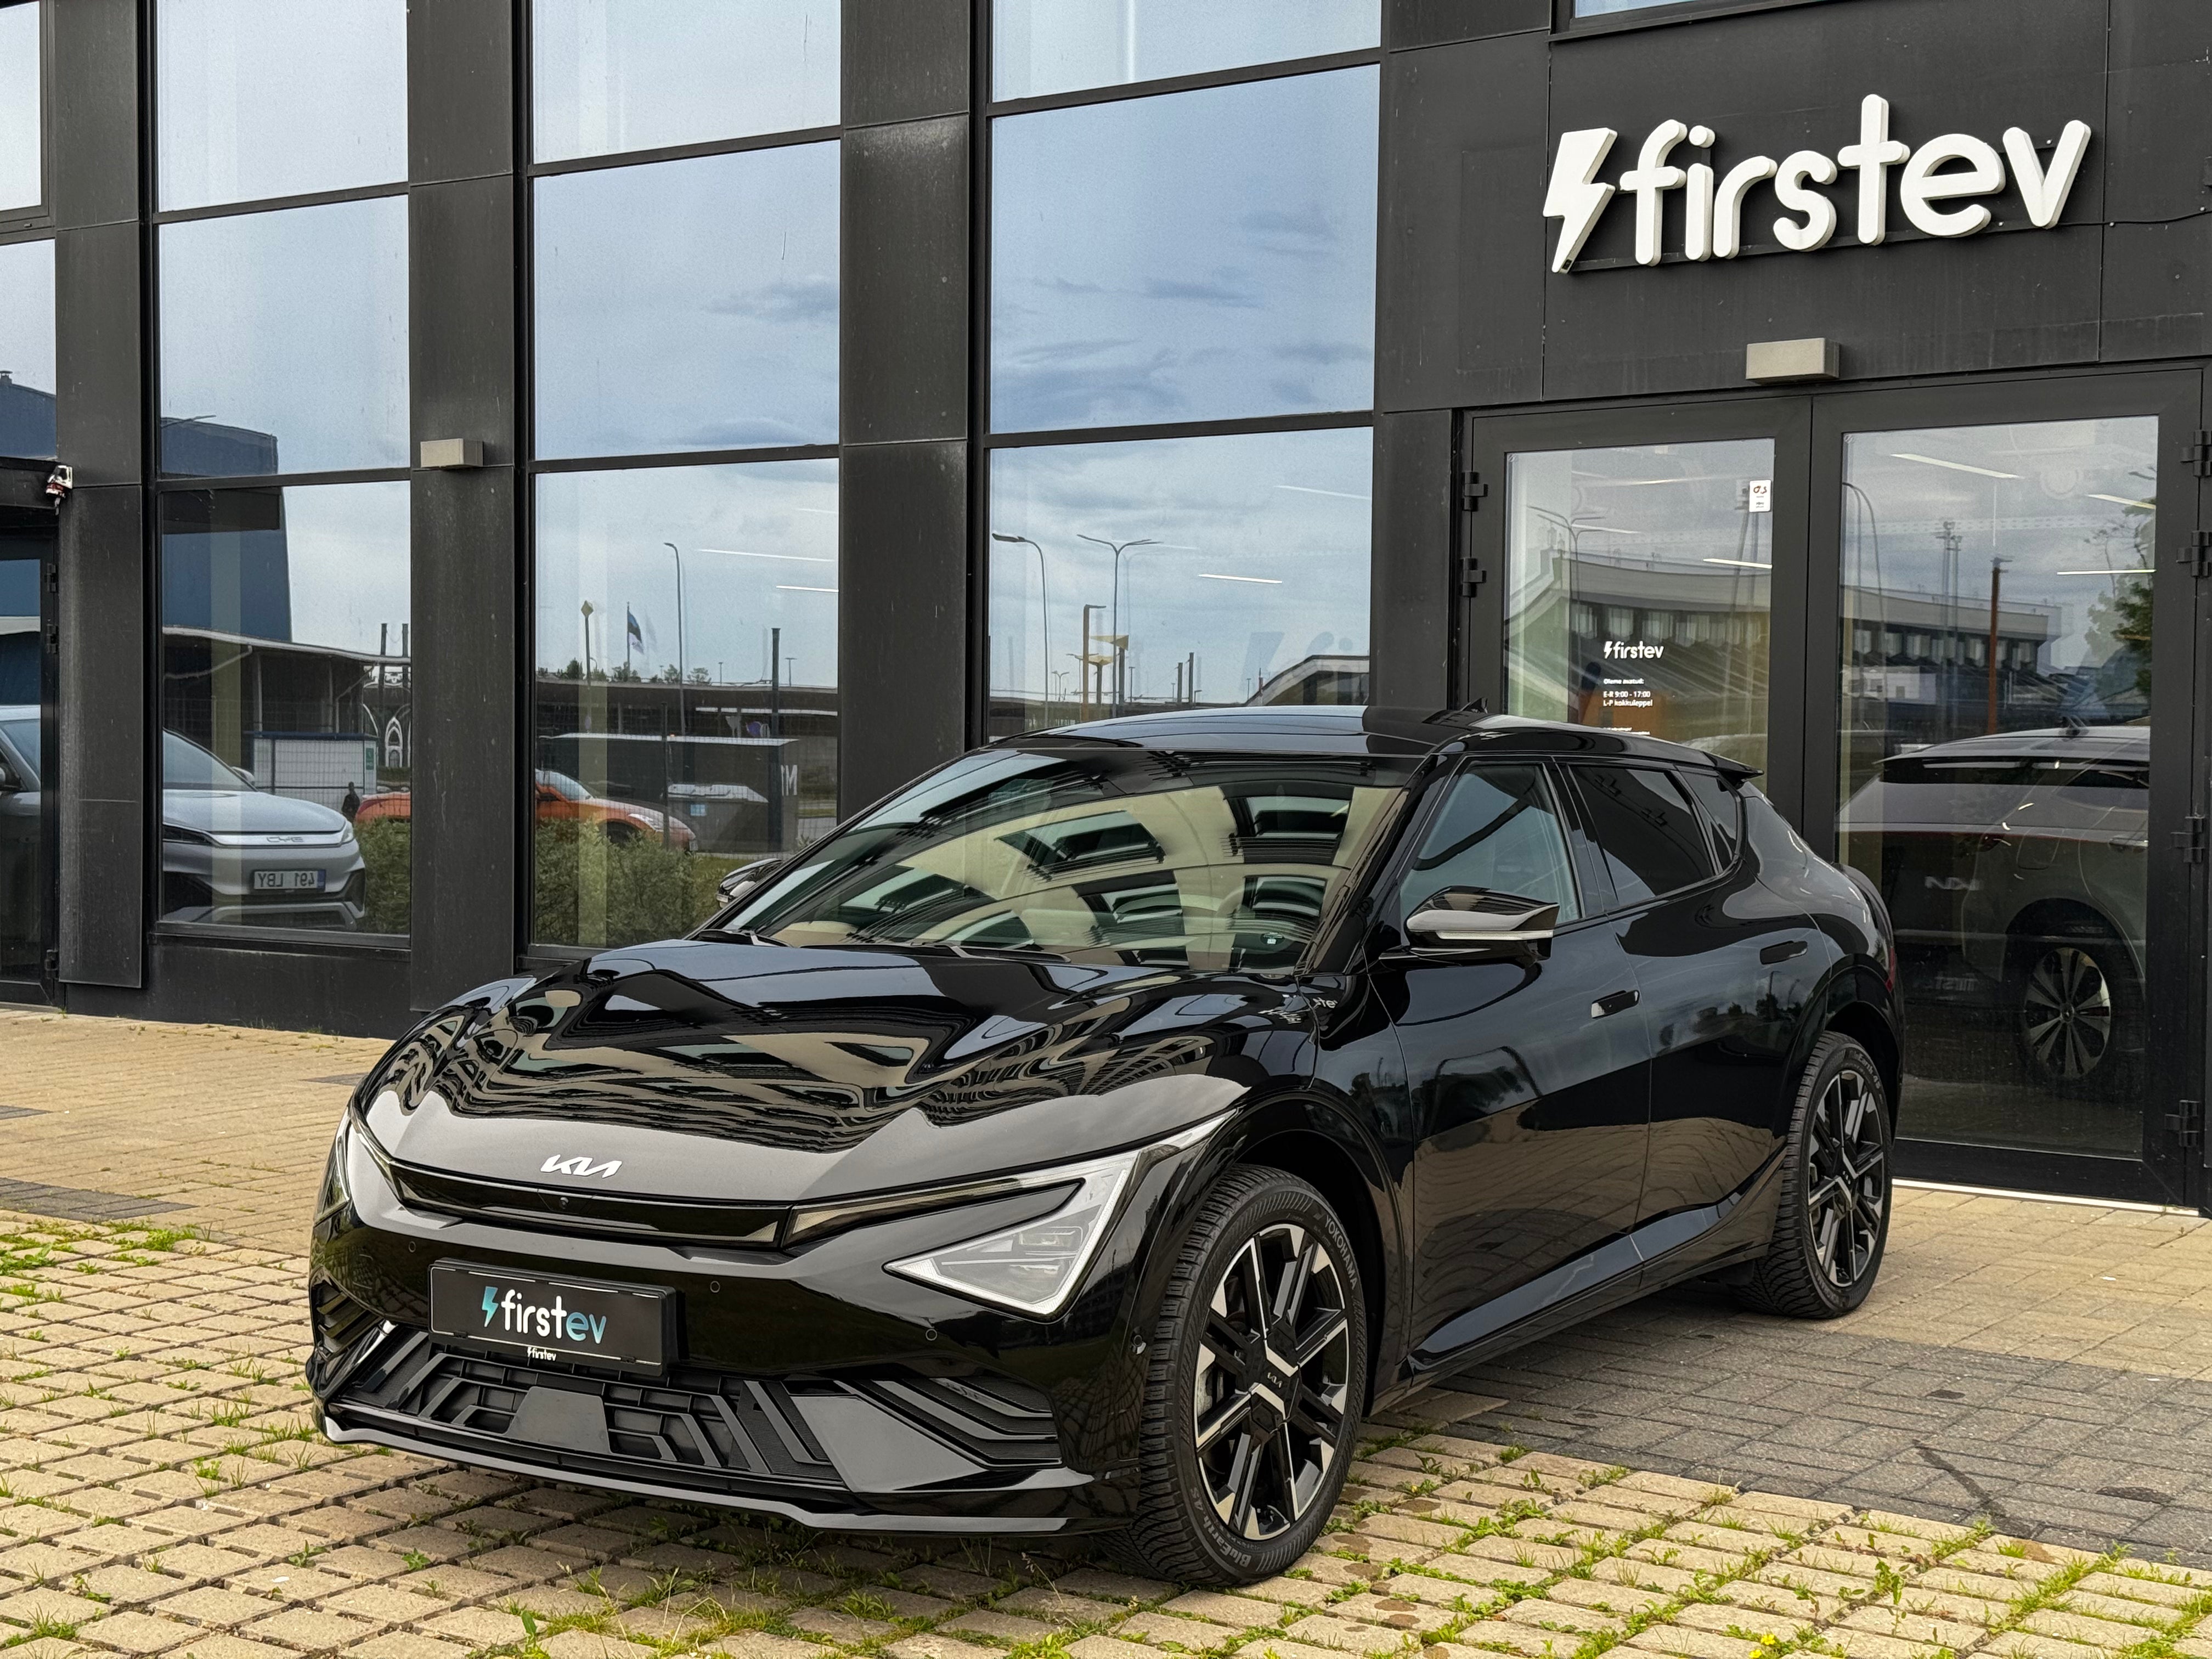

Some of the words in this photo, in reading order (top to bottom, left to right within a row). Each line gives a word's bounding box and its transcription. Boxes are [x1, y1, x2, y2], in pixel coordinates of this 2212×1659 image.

[1619, 94, 2091, 266] firstev
[1613, 640, 1664, 659] firstev
[540, 1154, 623, 1178] KIA
[1324, 1214, 1358, 1290] YOKOHAMA
[501, 1289, 607, 1344] firstev
[532, 1347, 556, 1361] firstev
